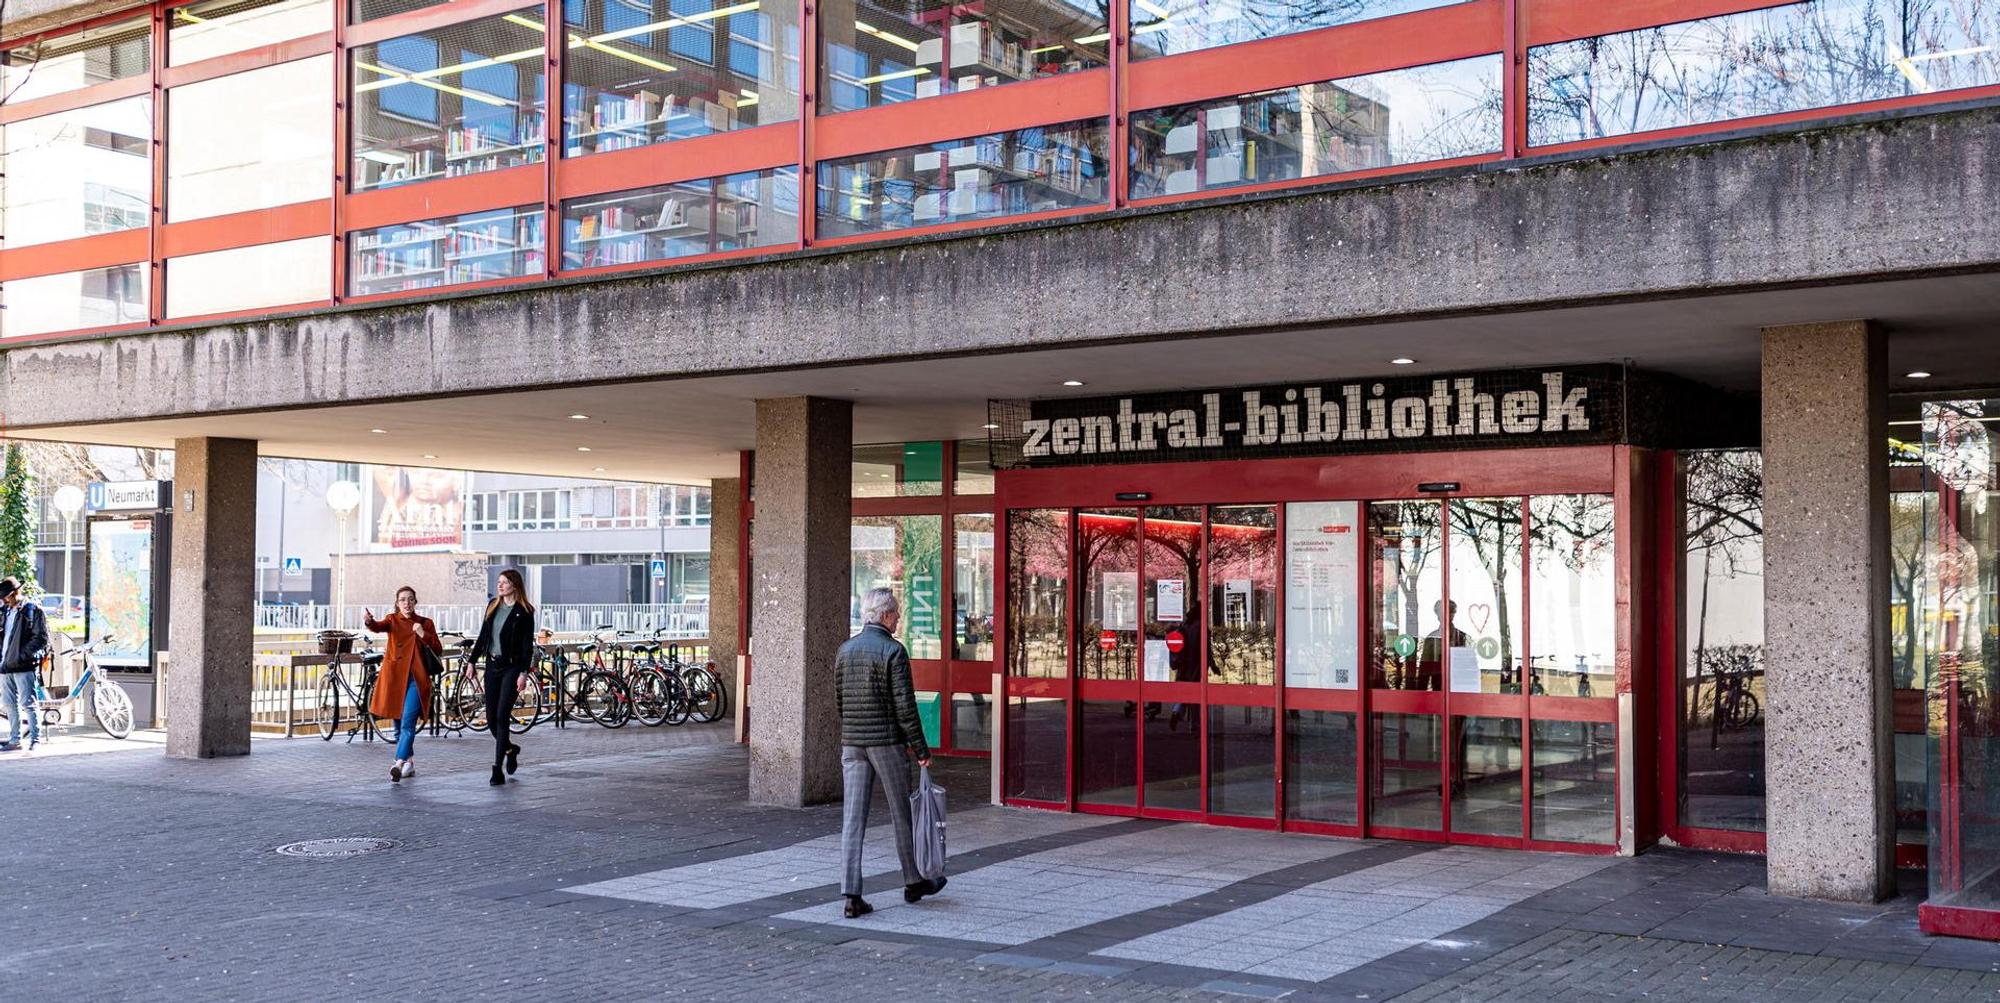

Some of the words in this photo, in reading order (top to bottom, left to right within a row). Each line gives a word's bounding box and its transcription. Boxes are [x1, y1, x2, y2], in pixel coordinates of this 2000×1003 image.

[1022, 371, 1590, 457] zentral-bibliothek
[90, 486, 104, 508] U
[108, 487, 155, 503] Neumarkt
[391, 537, 429, 548] COMING
[431, 535, 457, 545] SOON
